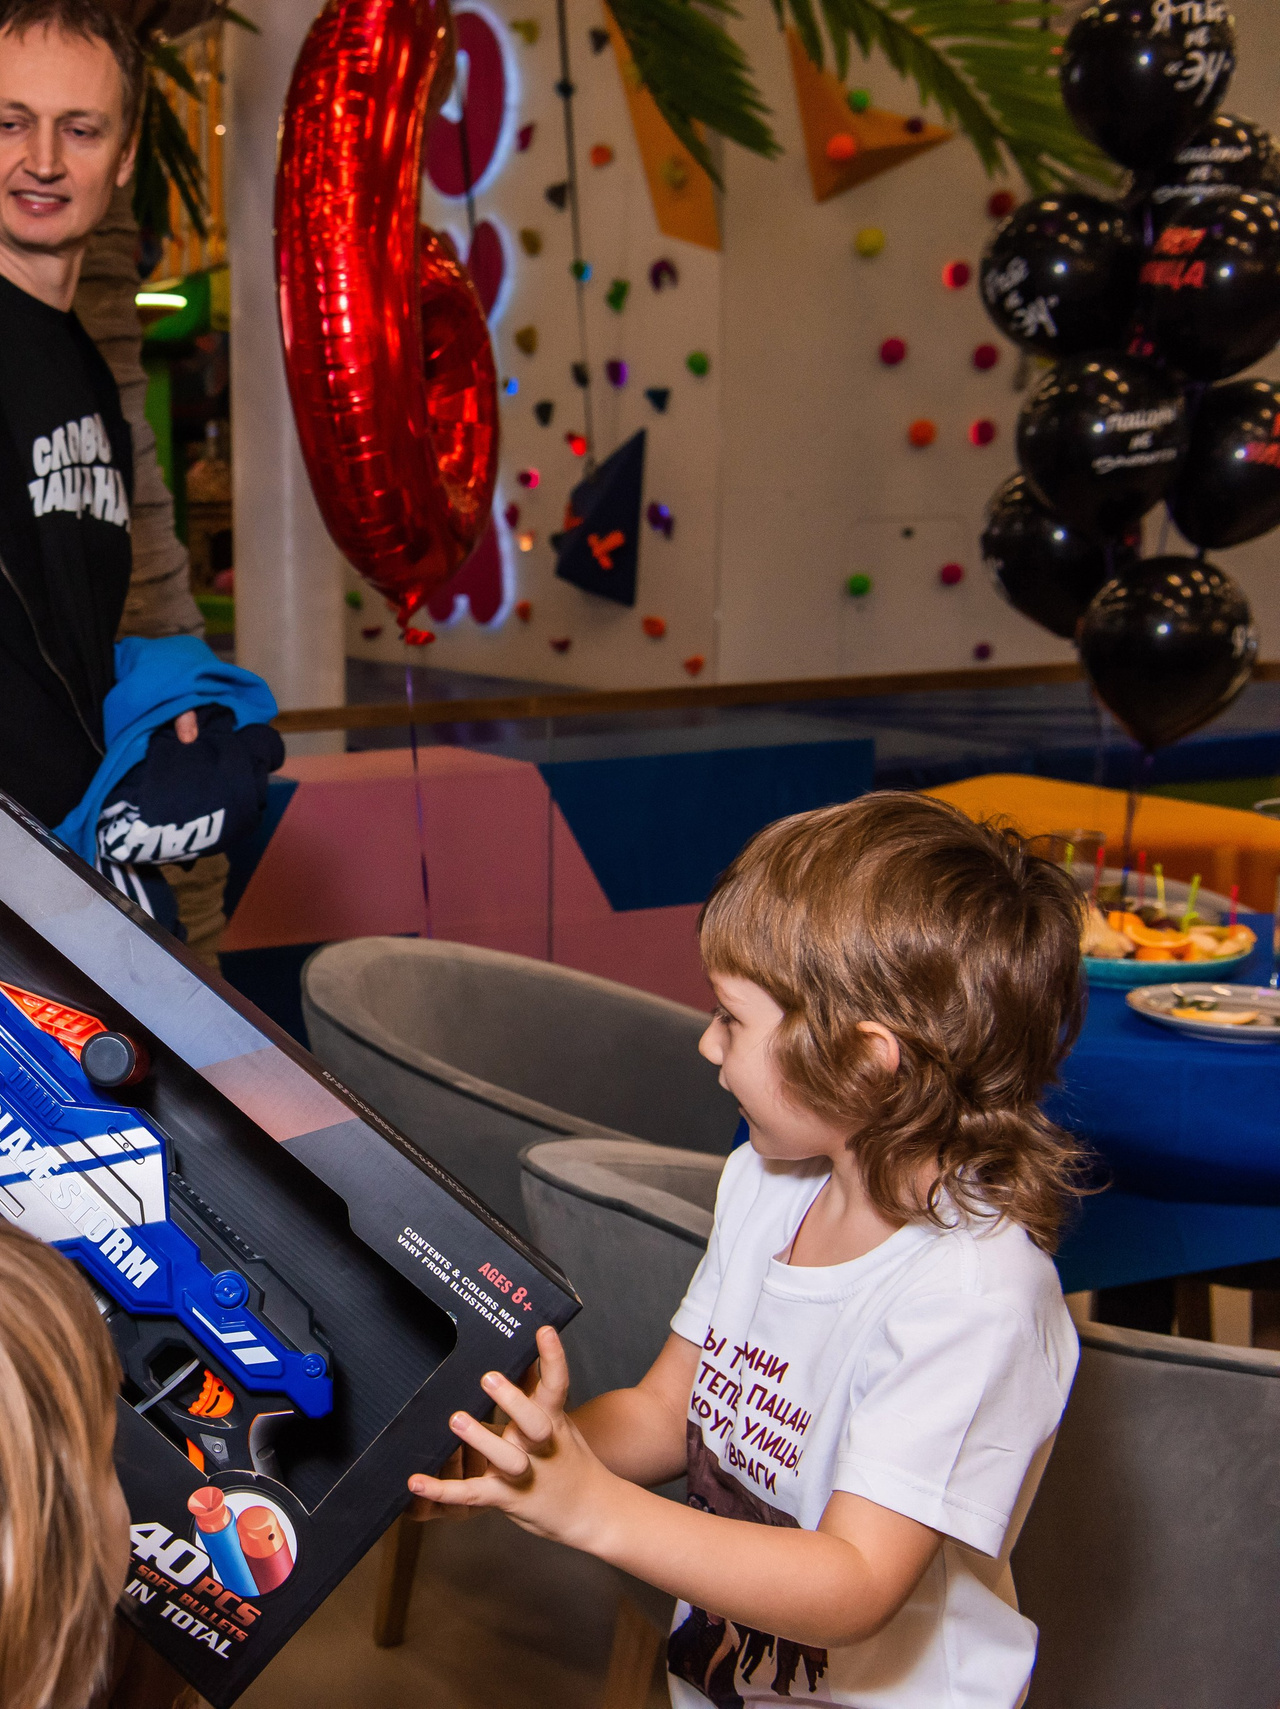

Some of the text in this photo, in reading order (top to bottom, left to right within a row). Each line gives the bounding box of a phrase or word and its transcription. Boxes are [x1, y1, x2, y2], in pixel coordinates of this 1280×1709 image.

[50, 1176, 159, 1289] STORM
[403, 1226, 452, 1270] CONTENTS
[451, 1268, 461, 1279] &
[461, 1276, 499, 1311] COLORS
[498, 1308, 522, 1329] MAY
[397, 1234, 515, 1339] VARY FROM ILLUSTRATION
[477, 1262, 533, 1312] AGES 8+
[124, 1578, 232, 1660] IN TOTAL
[130, 1521, 262, 1627] 40 PCS
[135, 1564, 249, 1643] SOFT BULLETS
